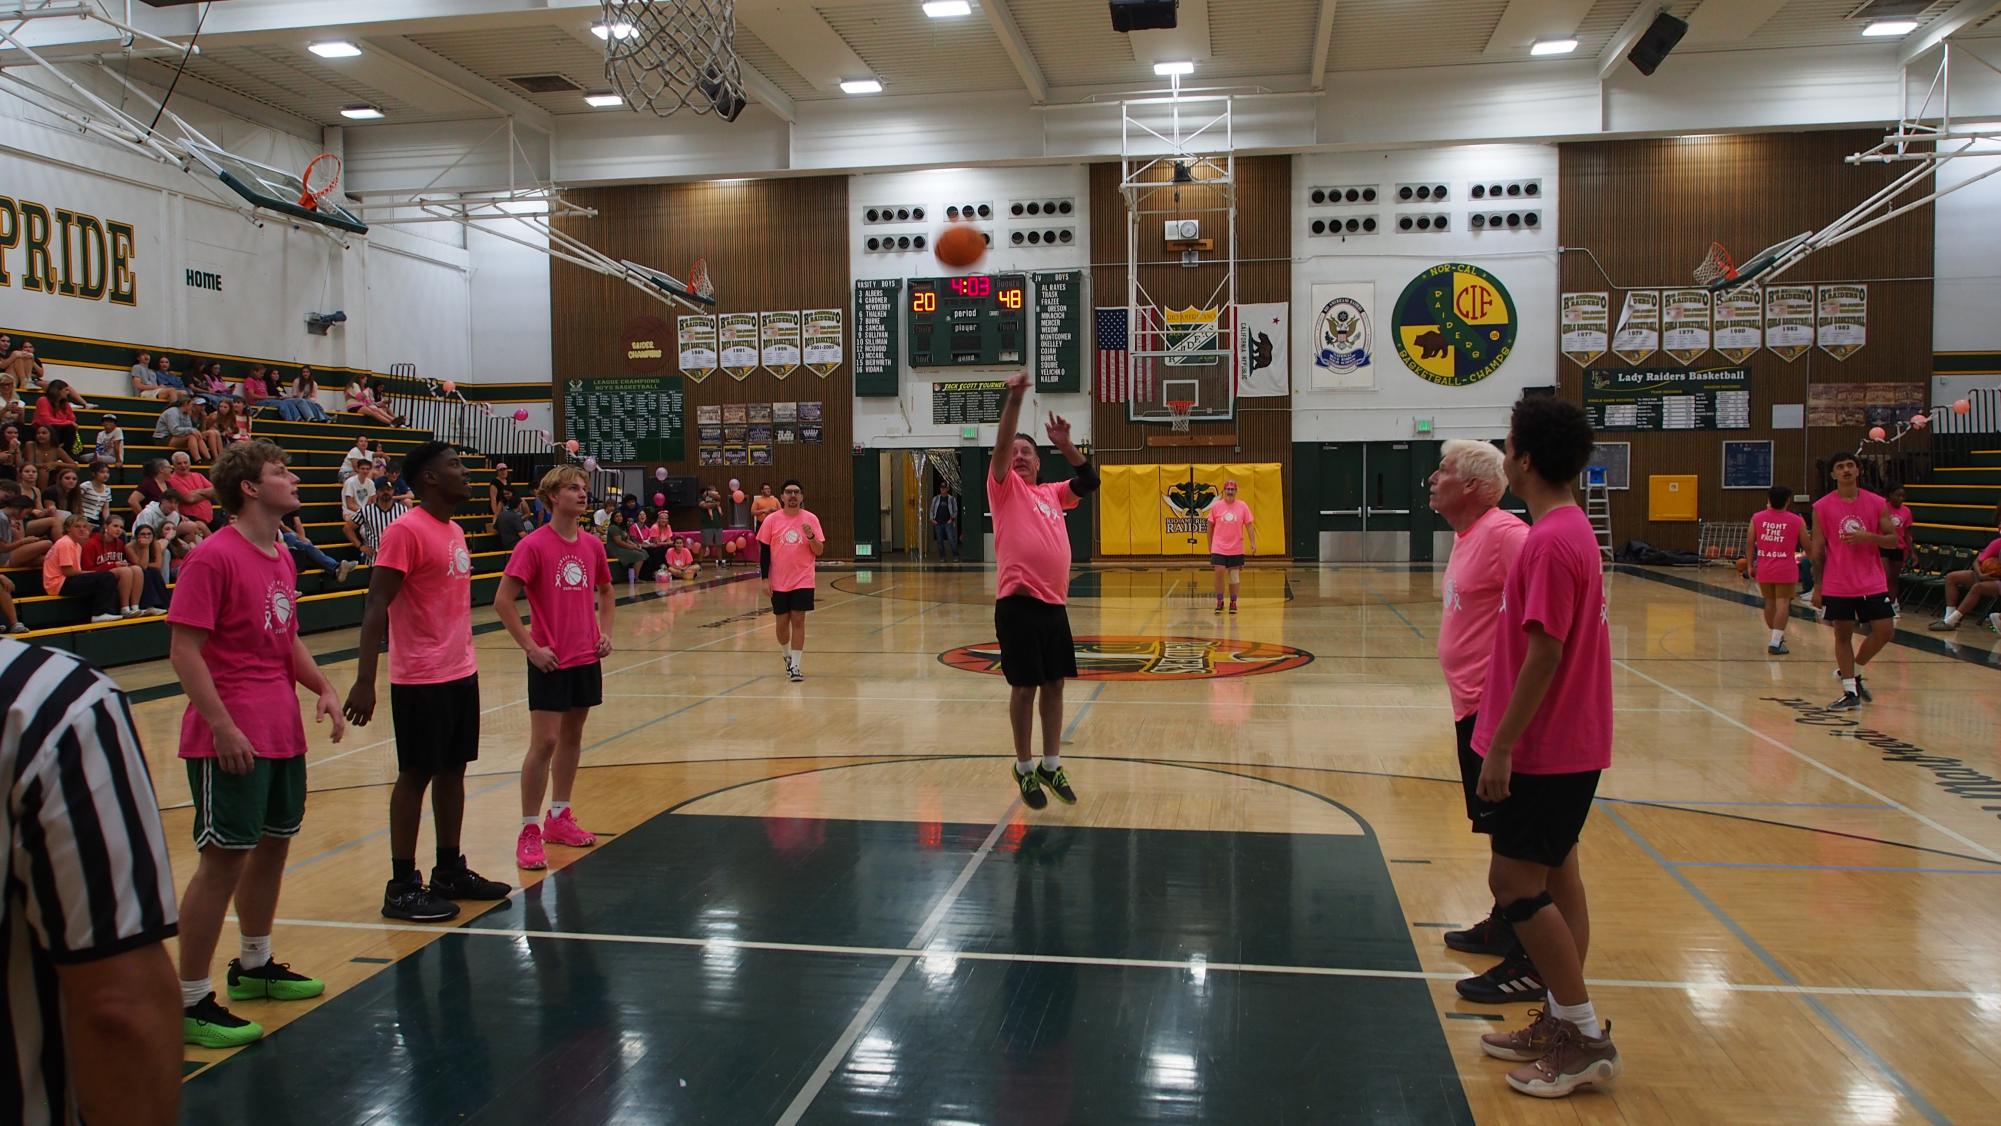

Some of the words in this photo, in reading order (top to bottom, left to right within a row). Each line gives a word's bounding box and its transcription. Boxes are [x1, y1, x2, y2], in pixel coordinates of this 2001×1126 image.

[0, 194, 137, 307] PRIDE
[1430, 264, 1477, 276] NOR-CAL
[186, 268, 222, 292] HOME
[882, 280, 896, 288] BOYS
[951, 276, 991, 297] 4:03
[914, 292, 936, 312] 20
[998, 289, 1022, 309] 48
[1456, 285, 1492, 320] CIF
[954, 309, 976, 318] period
[954, 324, 976, 332] player
[1618, 373, 1644, 383] Lady
[1646, 372, 1685, 381] Raiders
[1689, 371, 1744, 380] Basketball
[1168, 524, 1207, 532] RAIDE
[1763, 522, 1787, 530] FIGHT
[1761, 534, 1784, 543] FIGHT
